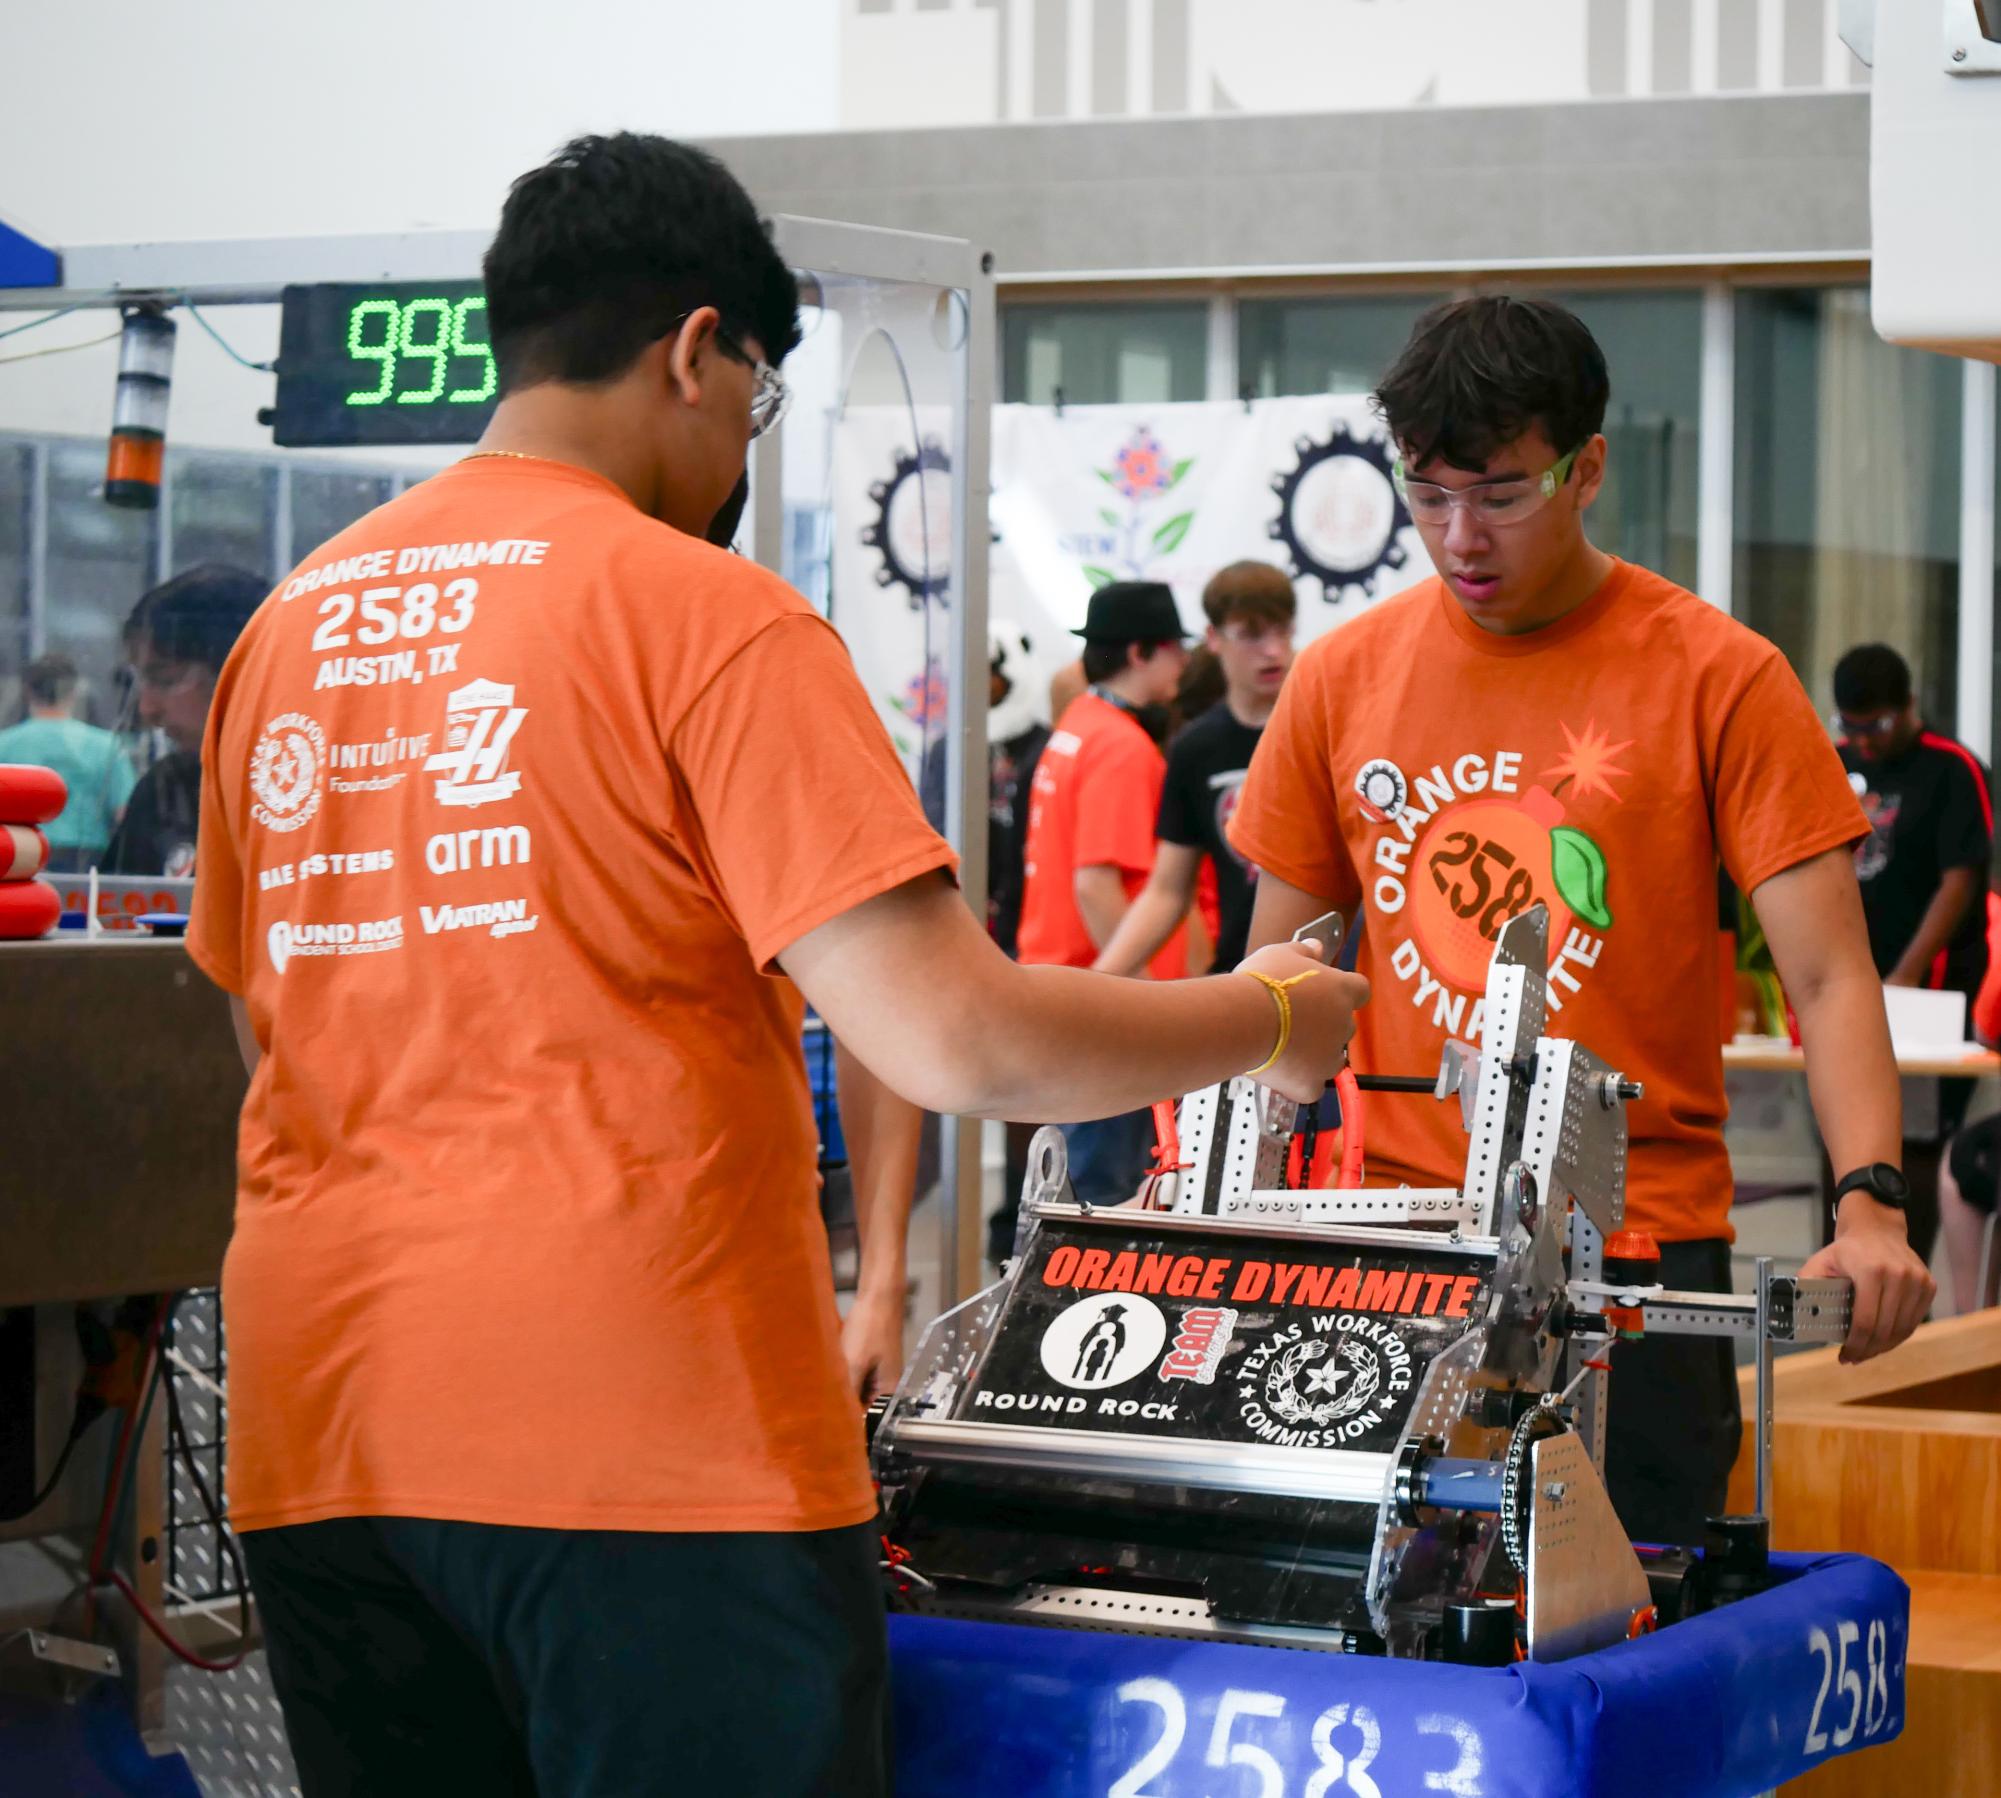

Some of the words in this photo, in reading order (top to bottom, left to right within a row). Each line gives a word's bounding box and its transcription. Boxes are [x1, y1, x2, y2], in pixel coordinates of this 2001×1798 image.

[281, 550, 395, 602] ORANGE
[396, 539, 552, 576] DYNAMITE
[311, 577, 479, 652] 2583
[426, 642, 462, 676] TX
[299, 849, 395, 880] SSTEMS
[425, 825, 531, 875] arm
[1374, 750, 1523, 914] ORANGE
[419, 898, 527, 934] VIATRAN
[1429, 831, 1547, 942] 258
[1391, 927, 1603, 1039] DYNAITE
[1042, 1246, 1232, 1299] ORANGE
[1231, 1260, 1479, 1318] DYNAMITE
[1236, 1323, 1303, 1380] TEXAS
[1311, 1313, 1412, 1391] WORKFORCE
[974, 1391, 1088, 1414] ROUND
[1098, 1398, 1178, 1421] ROCK
[1239, 1401, 1382, 1447] COMMISSION
[1803, 1619, 1899, 1756] 258
